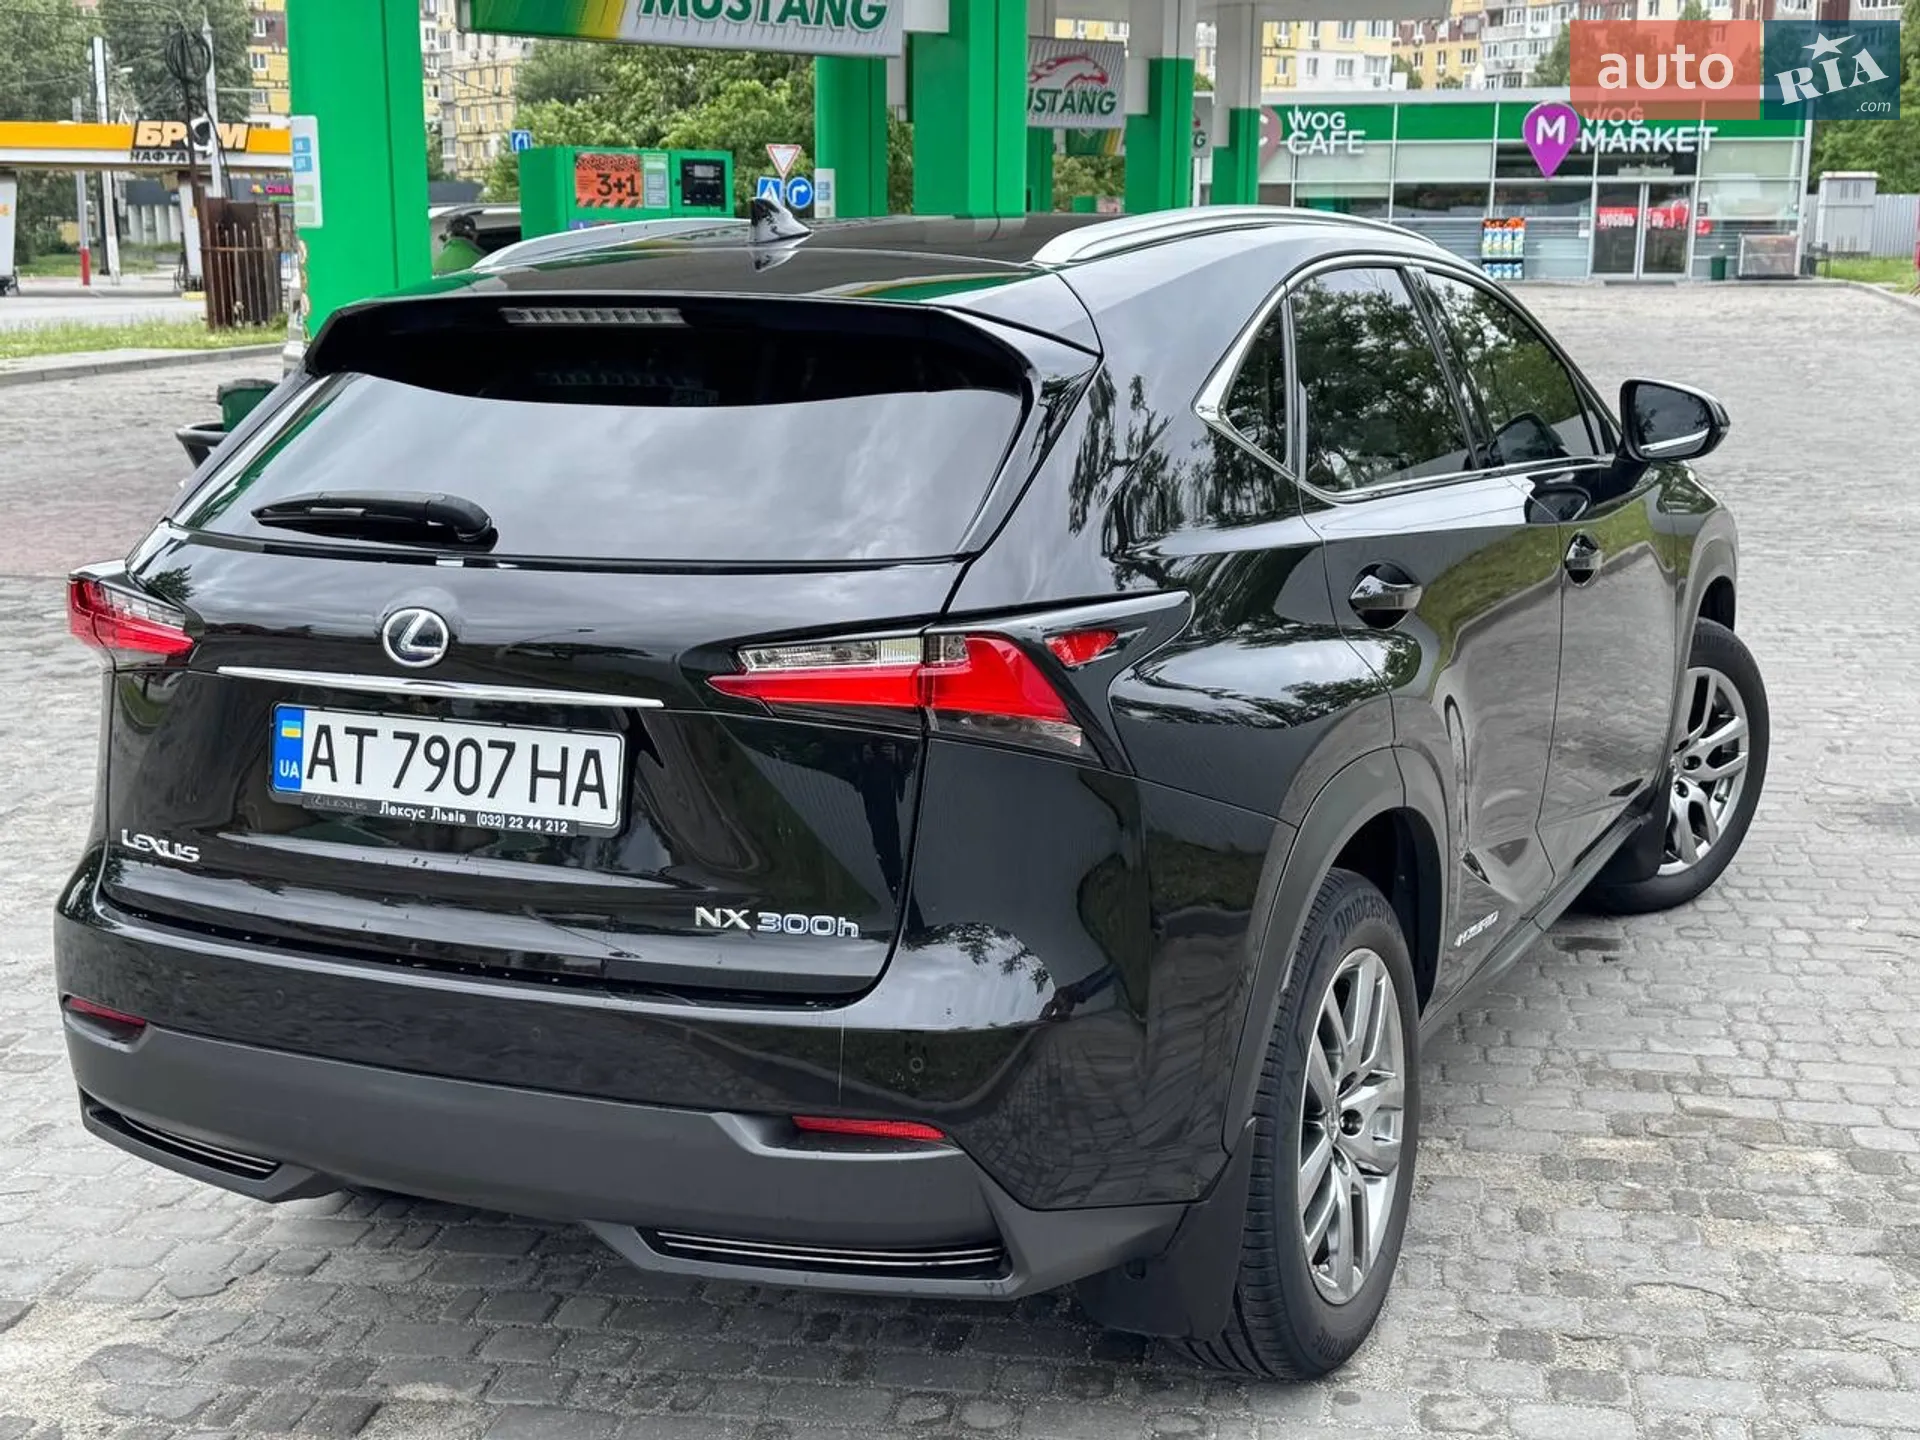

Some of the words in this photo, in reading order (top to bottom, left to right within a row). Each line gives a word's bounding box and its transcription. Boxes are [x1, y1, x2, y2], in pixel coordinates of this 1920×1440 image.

[1287, 111, 1346, 130] WOG
[1536, 115, 1566, 145] M
[1583, 107, 1644, 127] WOG
[1287, 130, 1366, 155] CAFE
[1580, 126, 1718, 153] MARKET
[596, 173, 639, 197] 3+1
[279, 760, 300, 778] UA
[306, 724, 378, 785] AT
[392, 730, 516, 799] 7907
[529, 743, 608, 810] HA
[379, 802, 426, 821] Лексус
[430, 807, 467, 823] Львів
[476, 812, 506, 828] (032)
[508, 817, 523, 830] 22
[527, 818, 541, 831] 44
[545, 820, 568, 833] 212
[121, 829, 200, 862] LEXUS
[695, 906, 751, 930] NX
[757, 911, 860, 938] 300h
